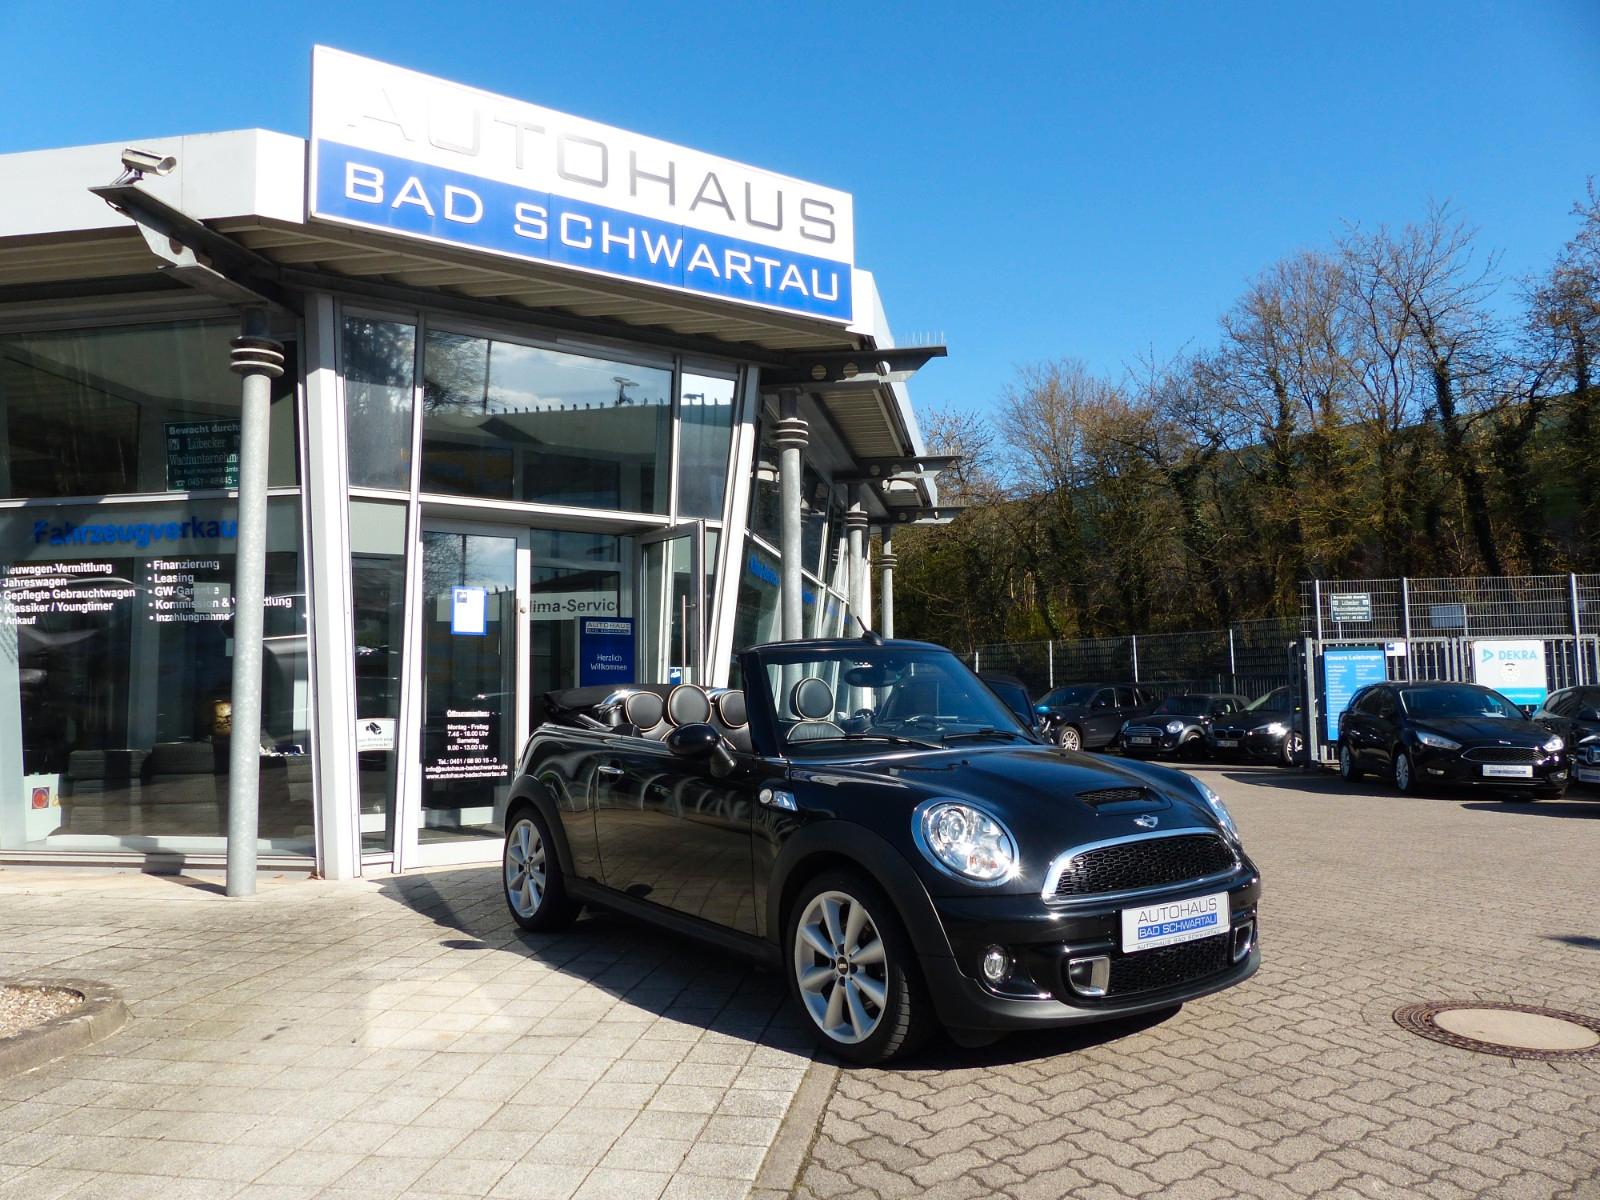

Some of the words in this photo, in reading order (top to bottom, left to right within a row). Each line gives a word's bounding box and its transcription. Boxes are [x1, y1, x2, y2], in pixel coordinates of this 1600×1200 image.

[346, 86, 837, 245] AUTOHAUS
[344, 160, 484, 225] BAD
[513, 202, 840, 302] SCHWARTAU
[32, 516, 238, 547] Fahrzeugverkau
[2, 562, 113, 575] Neuwagen-Vermittlung
[153, 560, 220, 571] Finanzierung
[2, 577, 68, 589] Jahreswagen
[154, 573, 195, 585] Leasing
[3, 590, 50, 602] Gepflegte
[52, 588, 136, 600] Gebrauchtwagen
[4, 603, 49, 614] Klassiker
[56, 602, 114, 614] Youngtimer
[530, 598, 618, 613] lima-Servic
[5, 616, 36, 625] Ankauf
[156, 612, 230, 623] Inzahlungnahme
[596, 653, 622, 662] Herzlich
[1498, 649, 1538, 660] DEKRA
[1137, 897, 1217, 924] AUTOHAUS
[1139, 926, 1160, 938] BAD
[1162, 915, 1217, 934] SCHWARTAU
